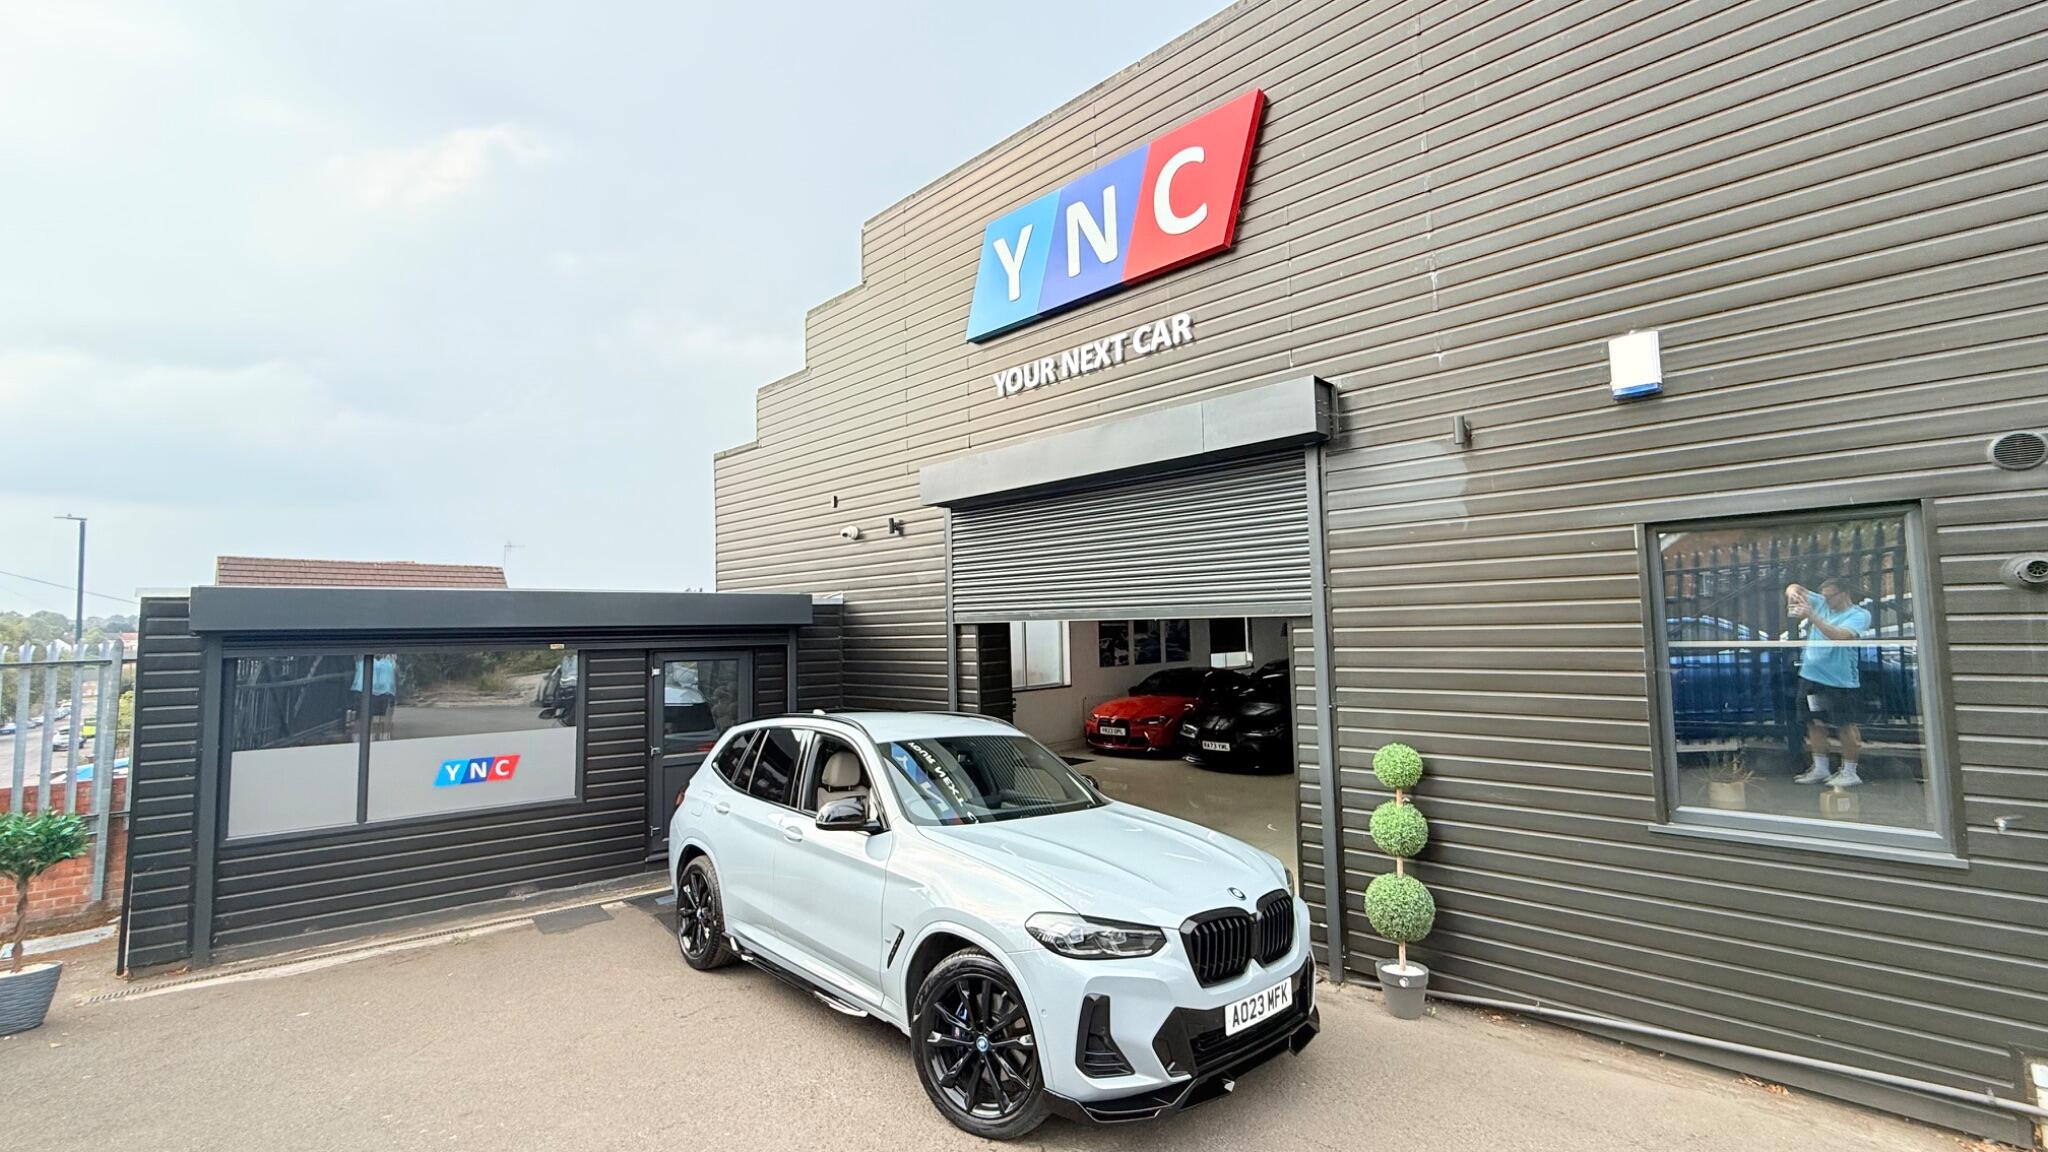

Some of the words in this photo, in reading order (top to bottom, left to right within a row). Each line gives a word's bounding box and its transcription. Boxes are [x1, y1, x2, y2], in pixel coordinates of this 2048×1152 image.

[993, 146, 1207, 302] YNC
[993, 359, 1057, 397] YOUR
[1061, 332, 1128, 377] NEXT
[1133, 312, 1195, 354] CAR
[445, 759, 510, 782] YNC
[1232, 994, 1265, 1028] AO23
[1267, 982, 1288, 1011] MFK
